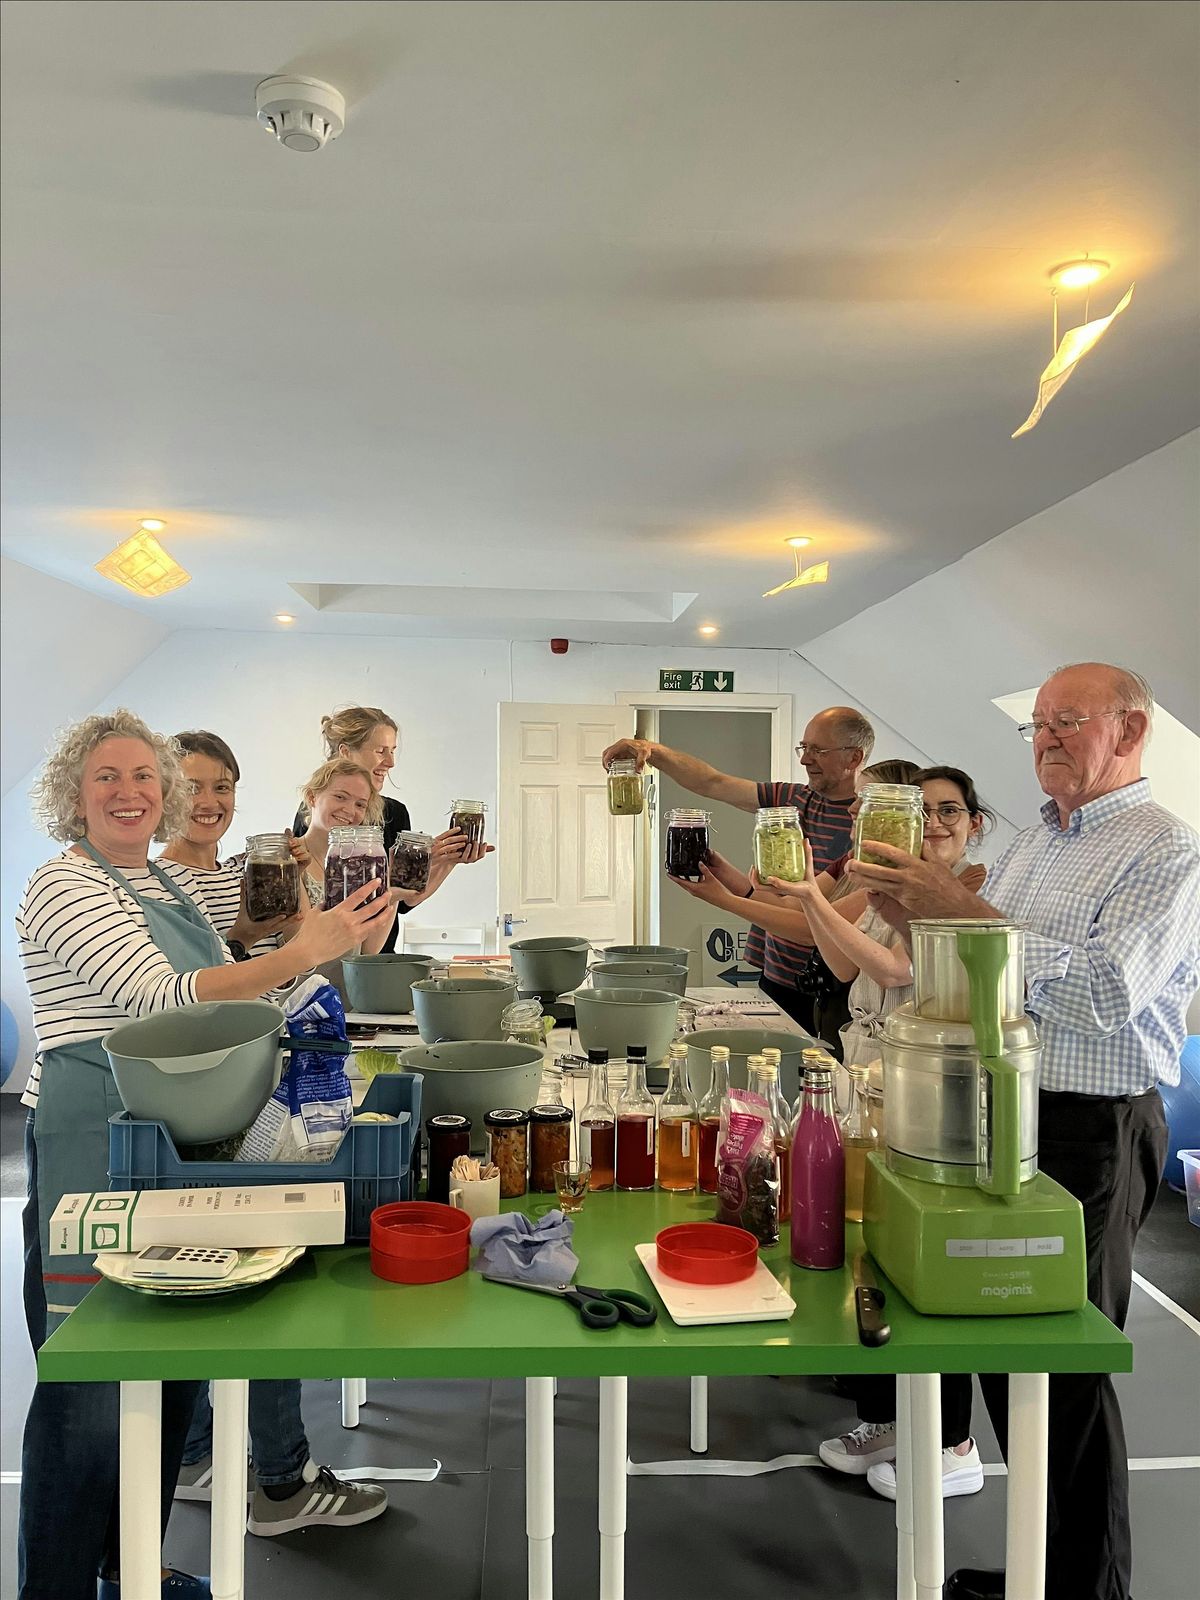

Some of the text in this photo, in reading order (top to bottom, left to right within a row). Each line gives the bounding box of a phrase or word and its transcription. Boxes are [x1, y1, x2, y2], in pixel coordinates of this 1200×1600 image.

[664, 672, 682, 680] Fire
[664, 681, 681, 689] exit
[981, 1283, 1033, 1299] magimix
